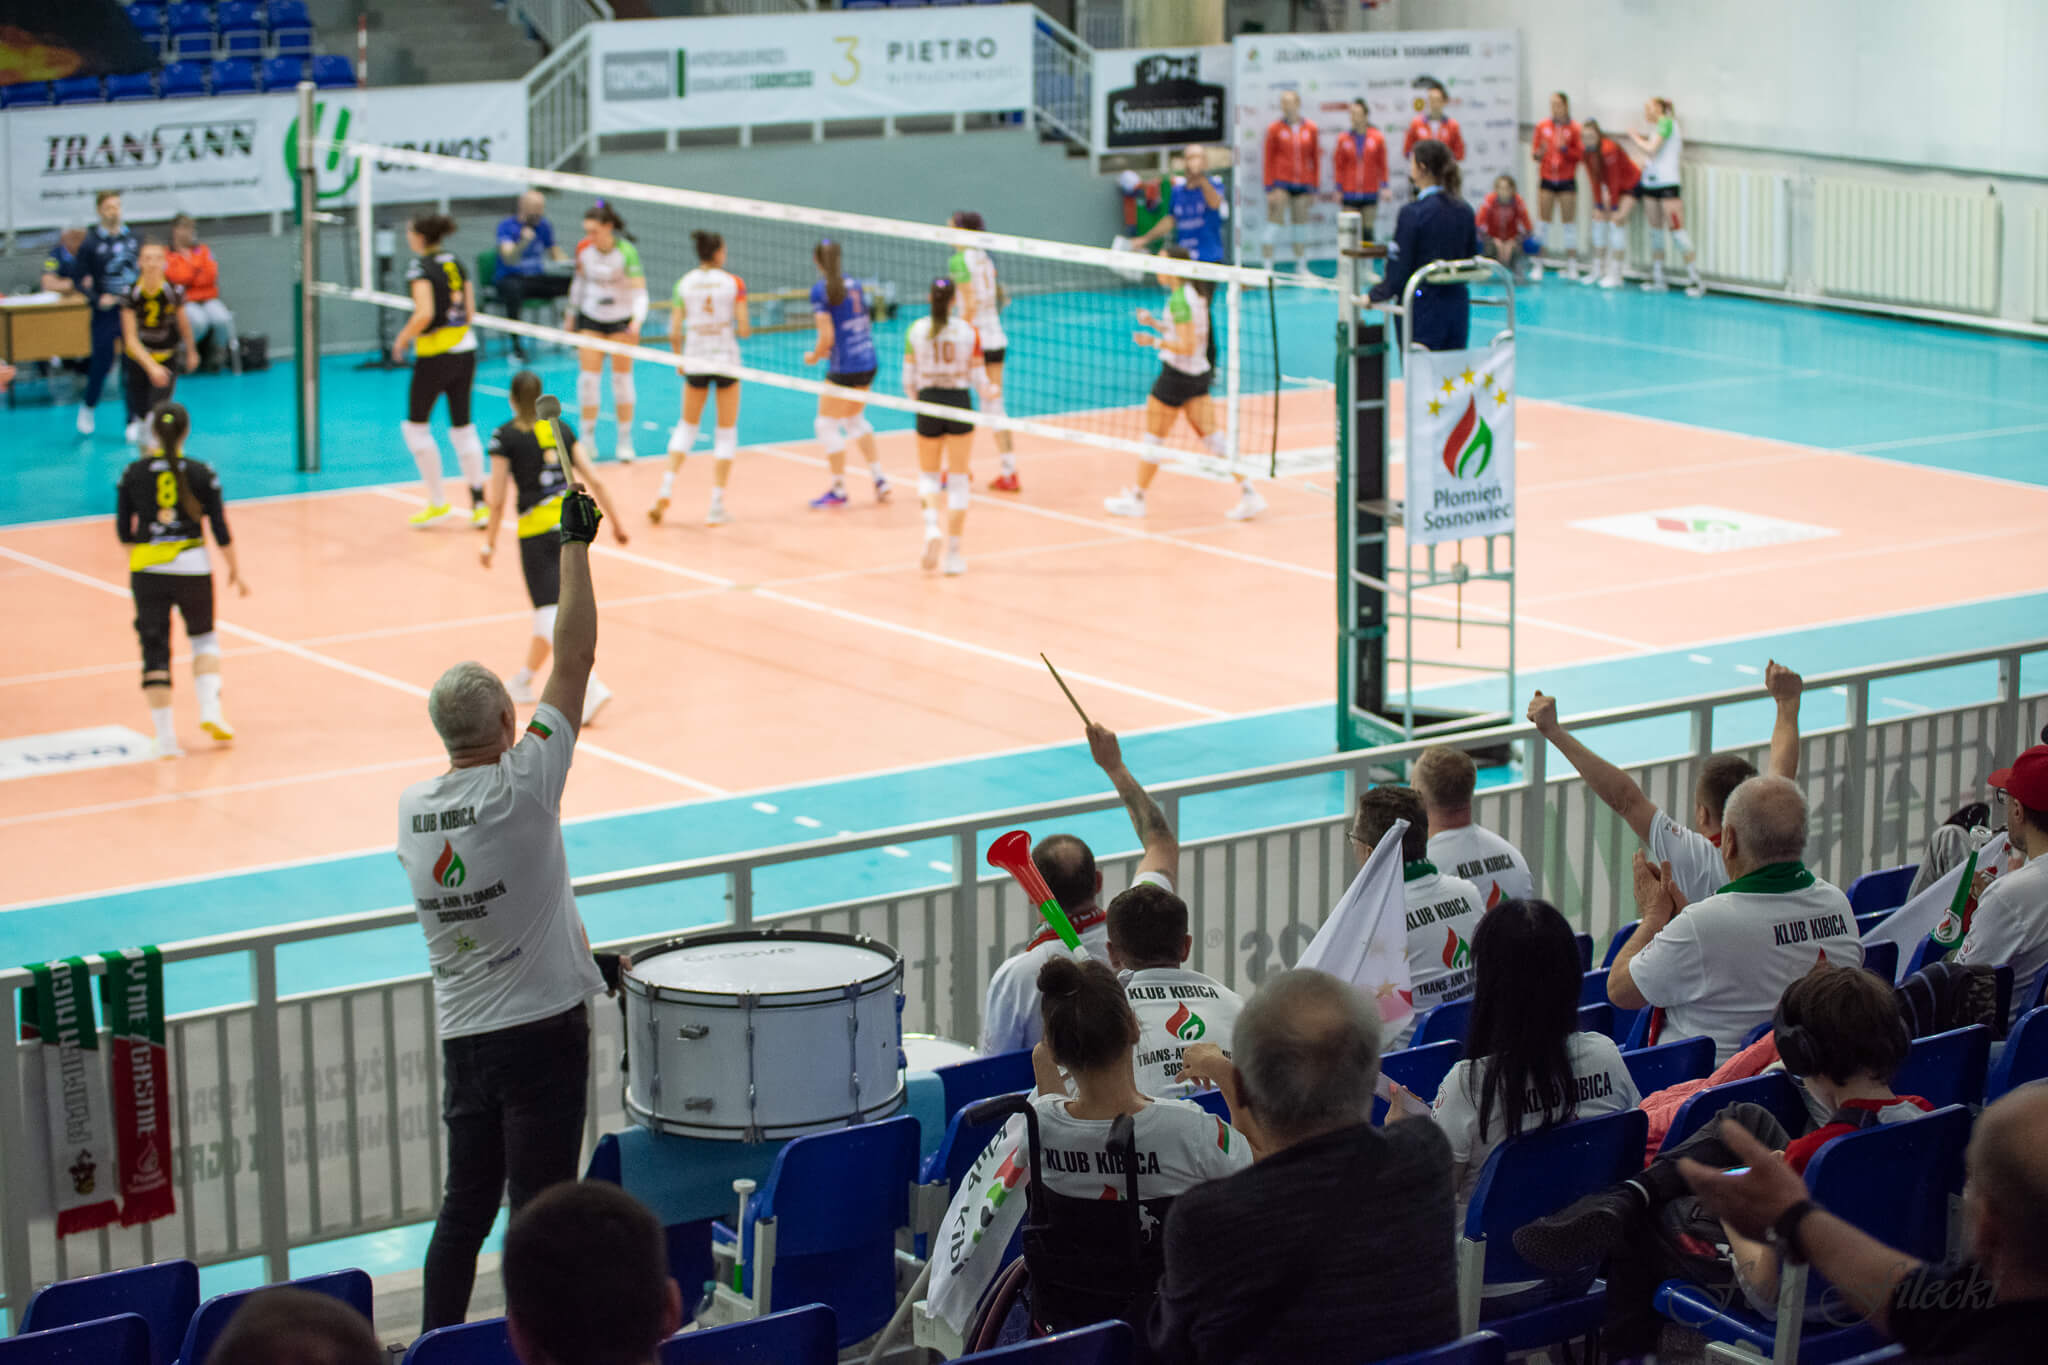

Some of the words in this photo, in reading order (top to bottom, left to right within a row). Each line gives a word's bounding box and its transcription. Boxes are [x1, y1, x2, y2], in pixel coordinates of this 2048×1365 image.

[887, 37, 998, 63] PIETRO
[932, 341, 956, 364] 10
[157, 472, 178, 508] 8
[1424, 500, 1512, 531] Sosnowiec
[412, 813, 437, 833] KLUB
[440, 806, 477, 831] KIBICA
[1457, 860, 1484, 879] KLUB
[1483, 854, 1515, 874] KIBICA
[1406, 906, 1435, 932] KLUB
[1434, 897, 1472, 921] KIBICA
[1774, 921, 1808, 946] KLUB
[1810, 914, 1848, 940] KIBICA
[1127, 986, 1166, 1000] KLUB
[1168, 985, 1220, 1000] KIBICA
[1137, 1047, 1184, 1067] TRANS-A
[1524, 1083, 1562, 1114] KLB
[1573, 1072, 1613, 1103] IBICA
[1044, 1148, 1090, 1173] KLUB
[1095, 1151, 1161, 1175] KIBCA
